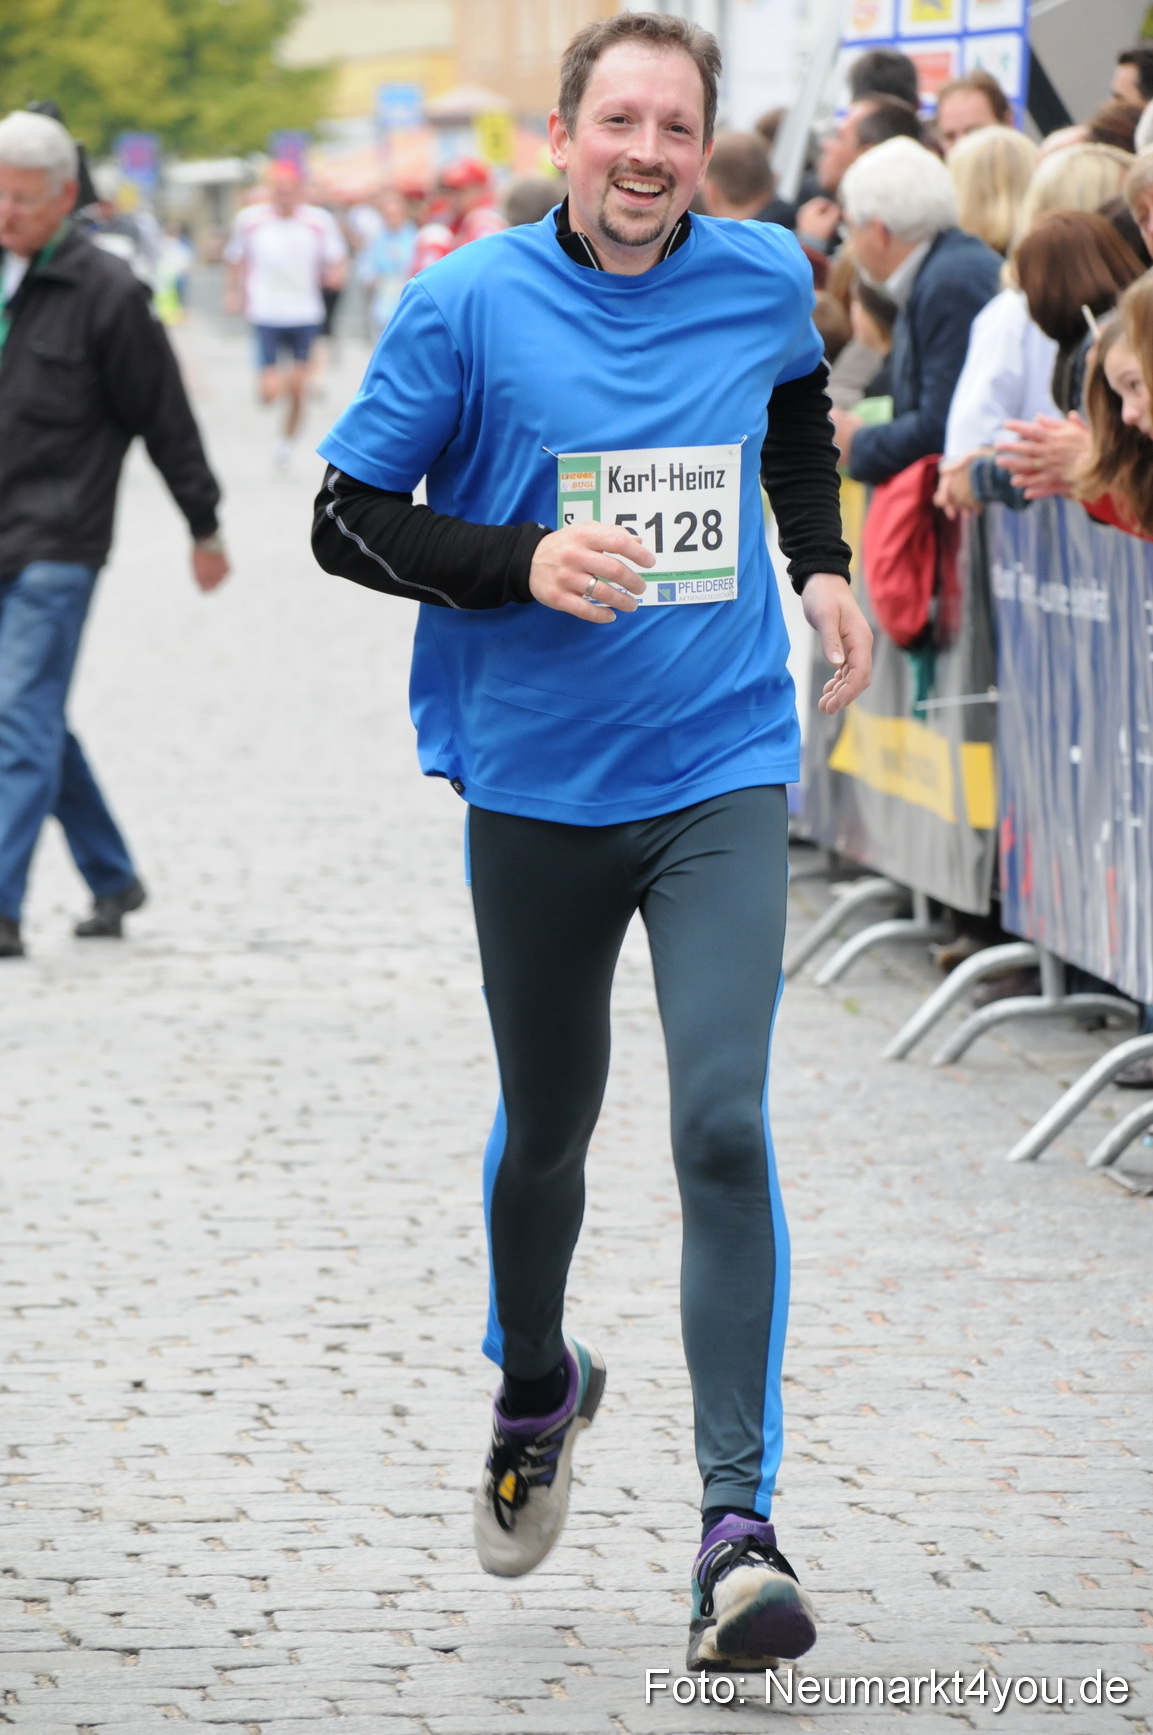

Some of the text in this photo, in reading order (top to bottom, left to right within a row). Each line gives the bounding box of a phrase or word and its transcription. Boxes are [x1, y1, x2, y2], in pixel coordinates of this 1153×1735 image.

[608, 462, 726, 493] Karl-Heinz
[614, 509, 723, 554] 5128
[678, 577, 735, 594] PFLEIDERER
